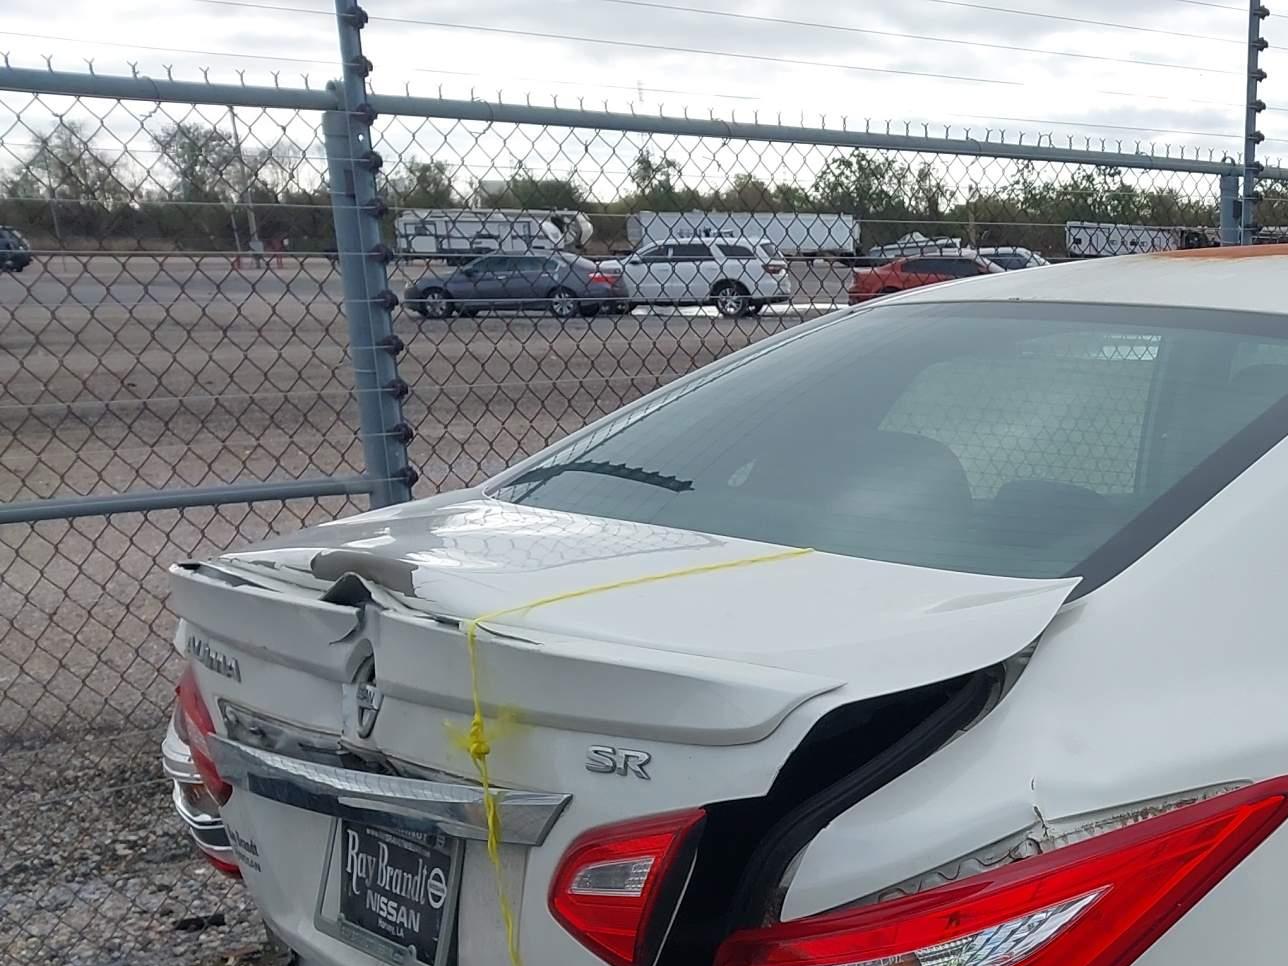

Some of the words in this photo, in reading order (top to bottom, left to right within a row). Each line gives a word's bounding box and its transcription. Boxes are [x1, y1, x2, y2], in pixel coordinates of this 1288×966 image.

[585, 744, 652, 781] SR
[346, 828, 377, 895] Ray
[376, 841, 428, 905] Brandt
[365, 888, 421, 933] NISSAN
